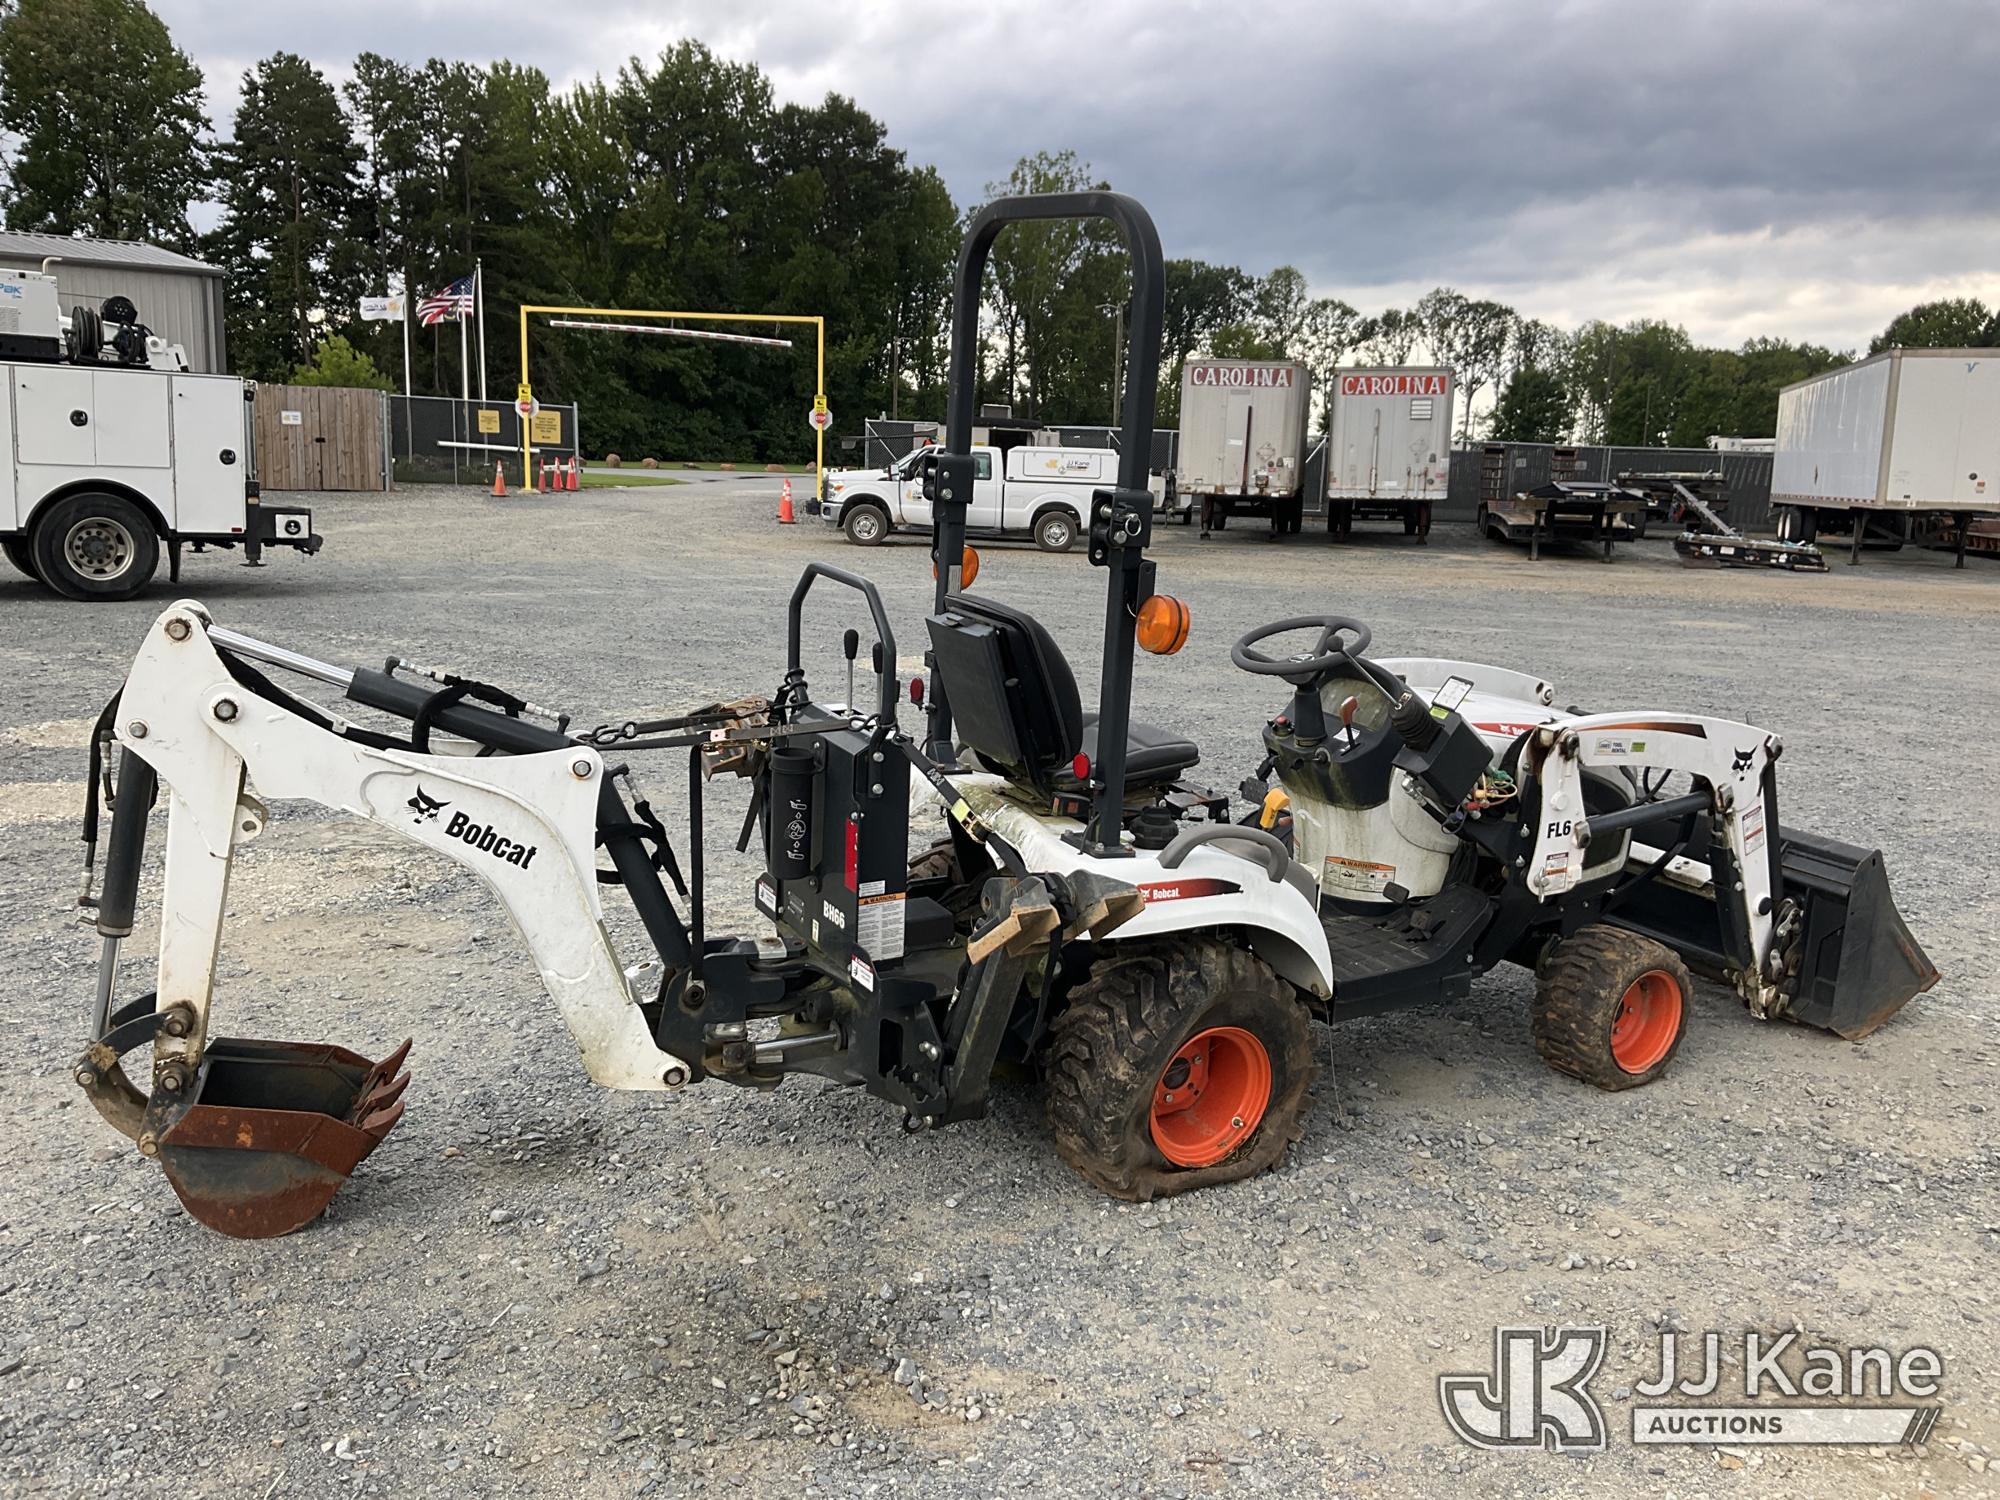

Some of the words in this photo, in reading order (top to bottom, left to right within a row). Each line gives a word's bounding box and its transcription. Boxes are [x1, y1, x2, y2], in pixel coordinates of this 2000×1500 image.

[1193, 368, 1290, 387] CAROLINA
[1344, 376, 1442, 395] CAROLINA
[1547, 821, 1572, 839] FL6
[444, 811, 537, 870] Bobcat
[1347, 861, 1380, 870] WARNING
[870, 895, 897, 904] WARNING
[1153, 888, 1180, 900] Bobcat
[823, 900, 845, 929] BH66
